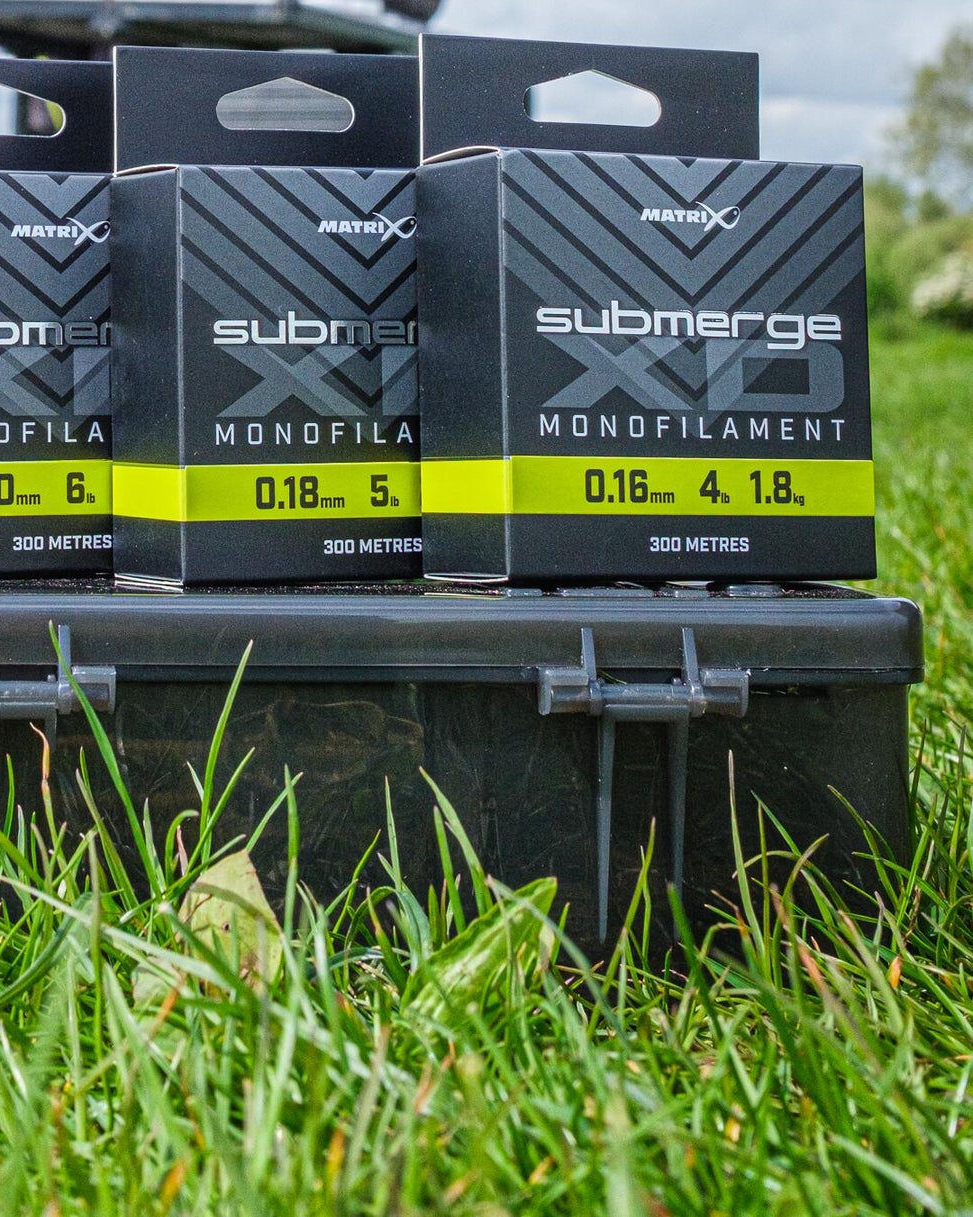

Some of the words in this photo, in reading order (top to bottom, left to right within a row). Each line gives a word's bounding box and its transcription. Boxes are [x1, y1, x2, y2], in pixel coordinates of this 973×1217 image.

[318, 212, 417, 241] MATRIX
[640, 201, 740, 231] MATRIX
[11, 217, 110, 246] MATRIX
[536, 300, 841, 350] submerge
[541, 335, 845, 412] XD
[215, 422, 414, 445] MONOFILA
[540, 413, 845, 441] MONOFILAMENT
[255, 476, 345, 510] 0.18mm
[585, 469, 675, 504] 0.16mm
[13, 536, 44, 550] 300
[49, 535, 112, 550] METRES
[323, 540, 355, 554] 300
[359, 538, 423, 554] METRES
[650, 537, 680, 552] 300
[686, 537, 749, 552] METRES
